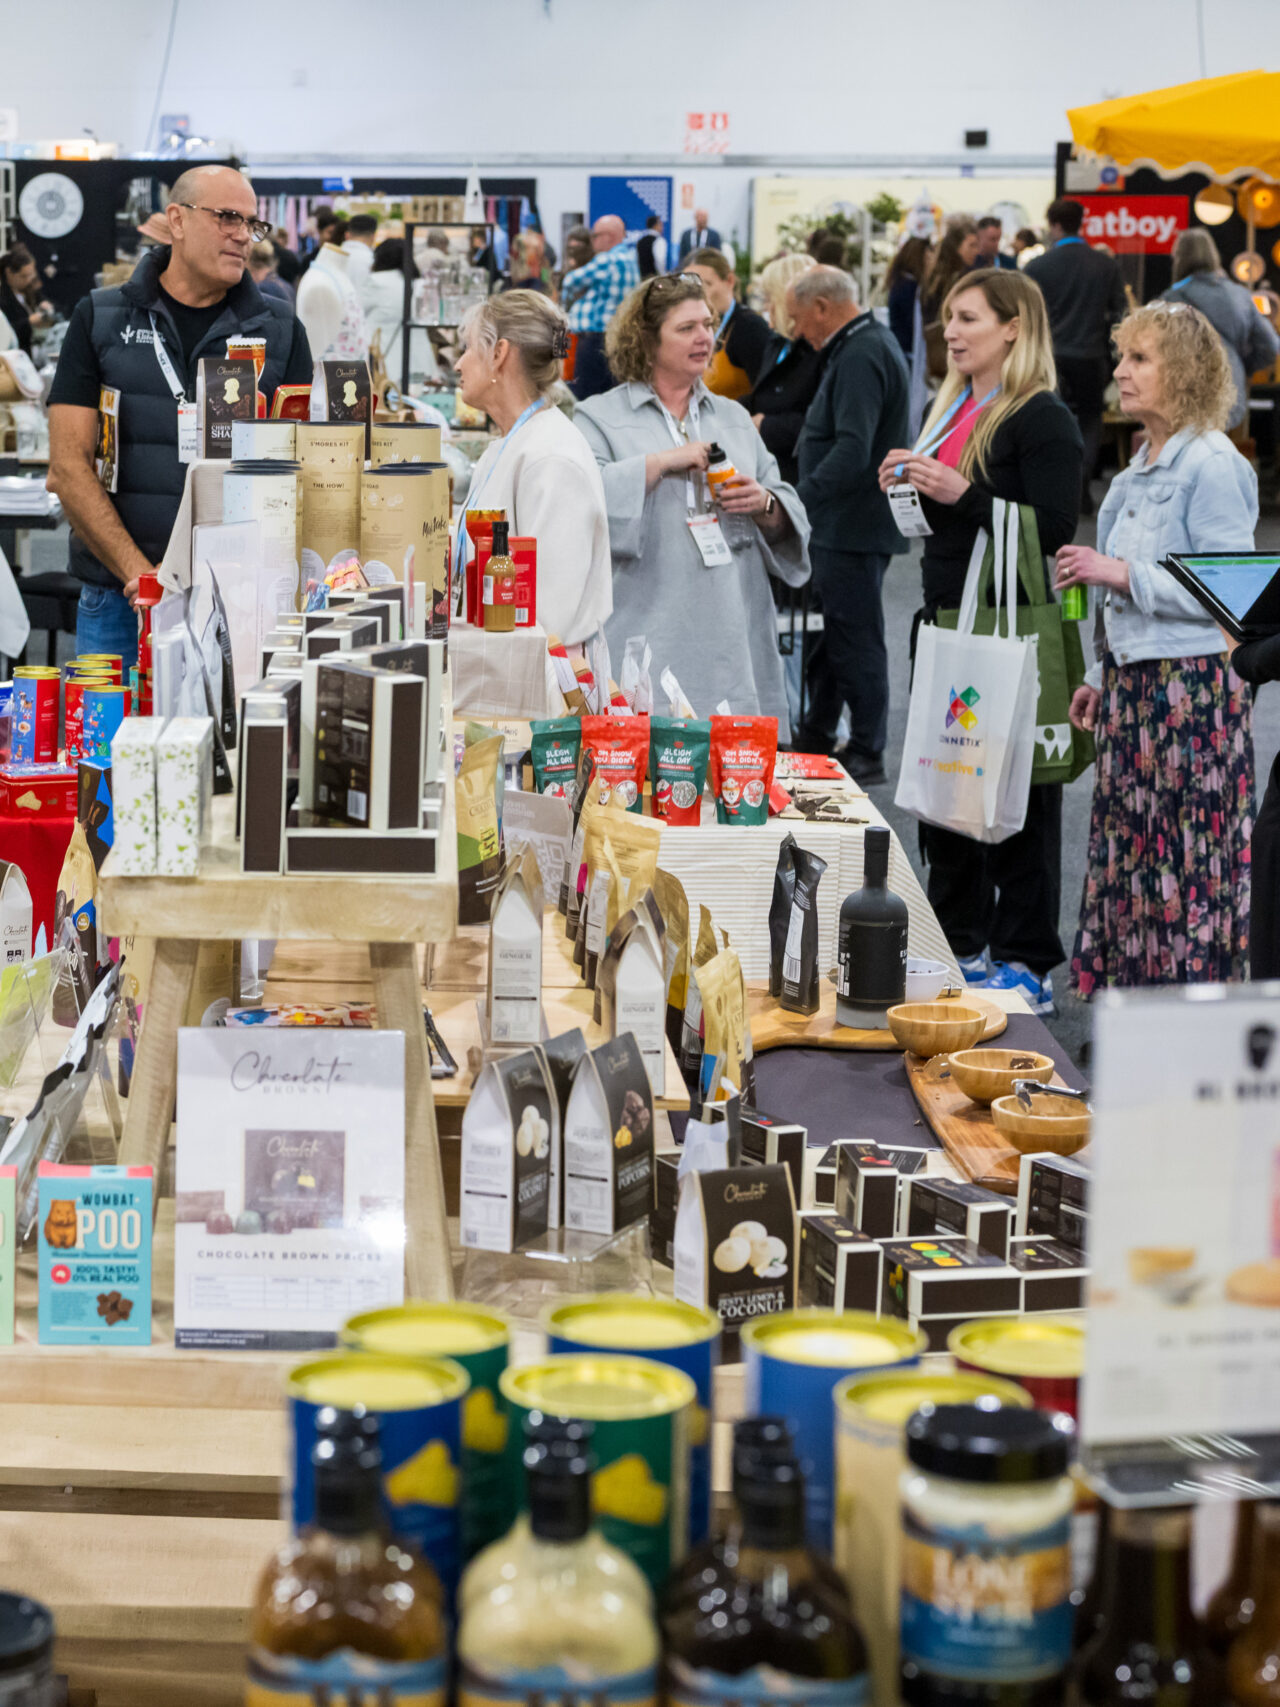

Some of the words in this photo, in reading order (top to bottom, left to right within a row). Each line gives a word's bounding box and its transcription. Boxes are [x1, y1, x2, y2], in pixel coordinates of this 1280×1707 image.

[663, 748, 693, 757] SLEIGH
[738, 749, 760, 757] SNOW
[659, 755, 674, 763] ALL
[82, 1193, 134, 1206] WOMBAT
[75, 1209, 141, 1249] POO
[197, 1250, 275, 1260] CHOCOLATE
[282, 1252, 329, 1260] BROWN
[717, 1299, 786, 1319] COCONUT
